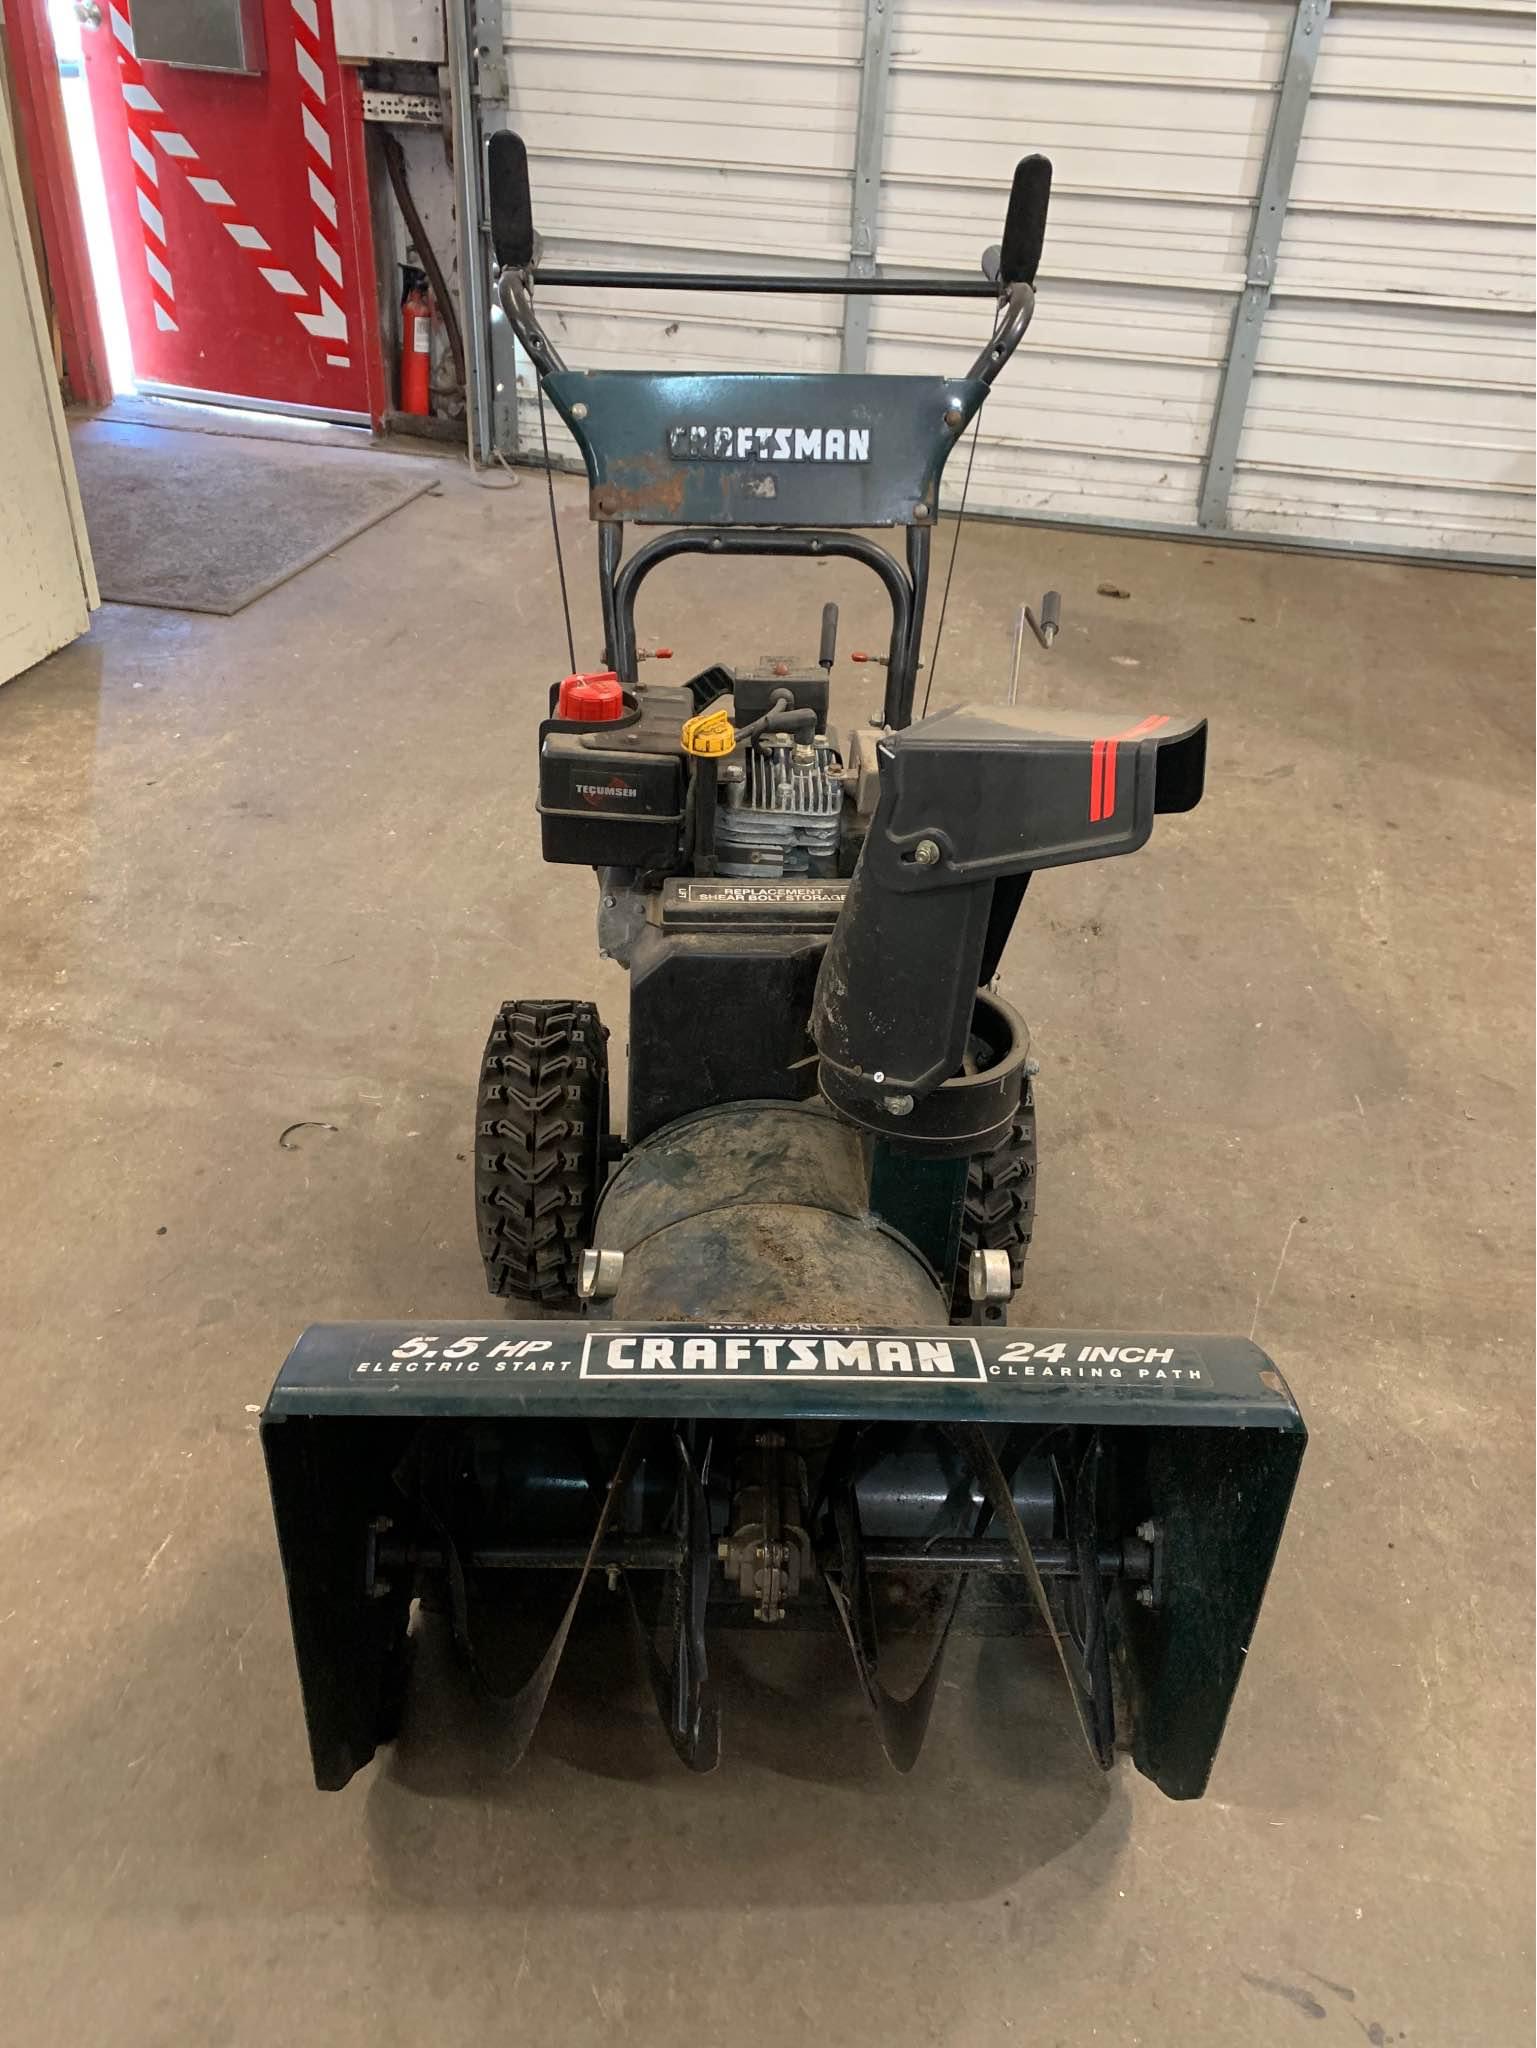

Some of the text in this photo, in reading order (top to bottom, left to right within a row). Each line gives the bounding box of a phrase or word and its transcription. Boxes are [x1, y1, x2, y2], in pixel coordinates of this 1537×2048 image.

[575, 784, 637, 797] TECUMSEH
[391, 1336, 553, 1359] 5.5 HP
[606, 1338, 956, 1373] CRAFTSMAN
[998, 1341, 1175, 1364] 24 INCH
[356, 1361, 572, 1372] ELECTRIC START
[989, 1365, 1201, 1380] CLEARING PATH
